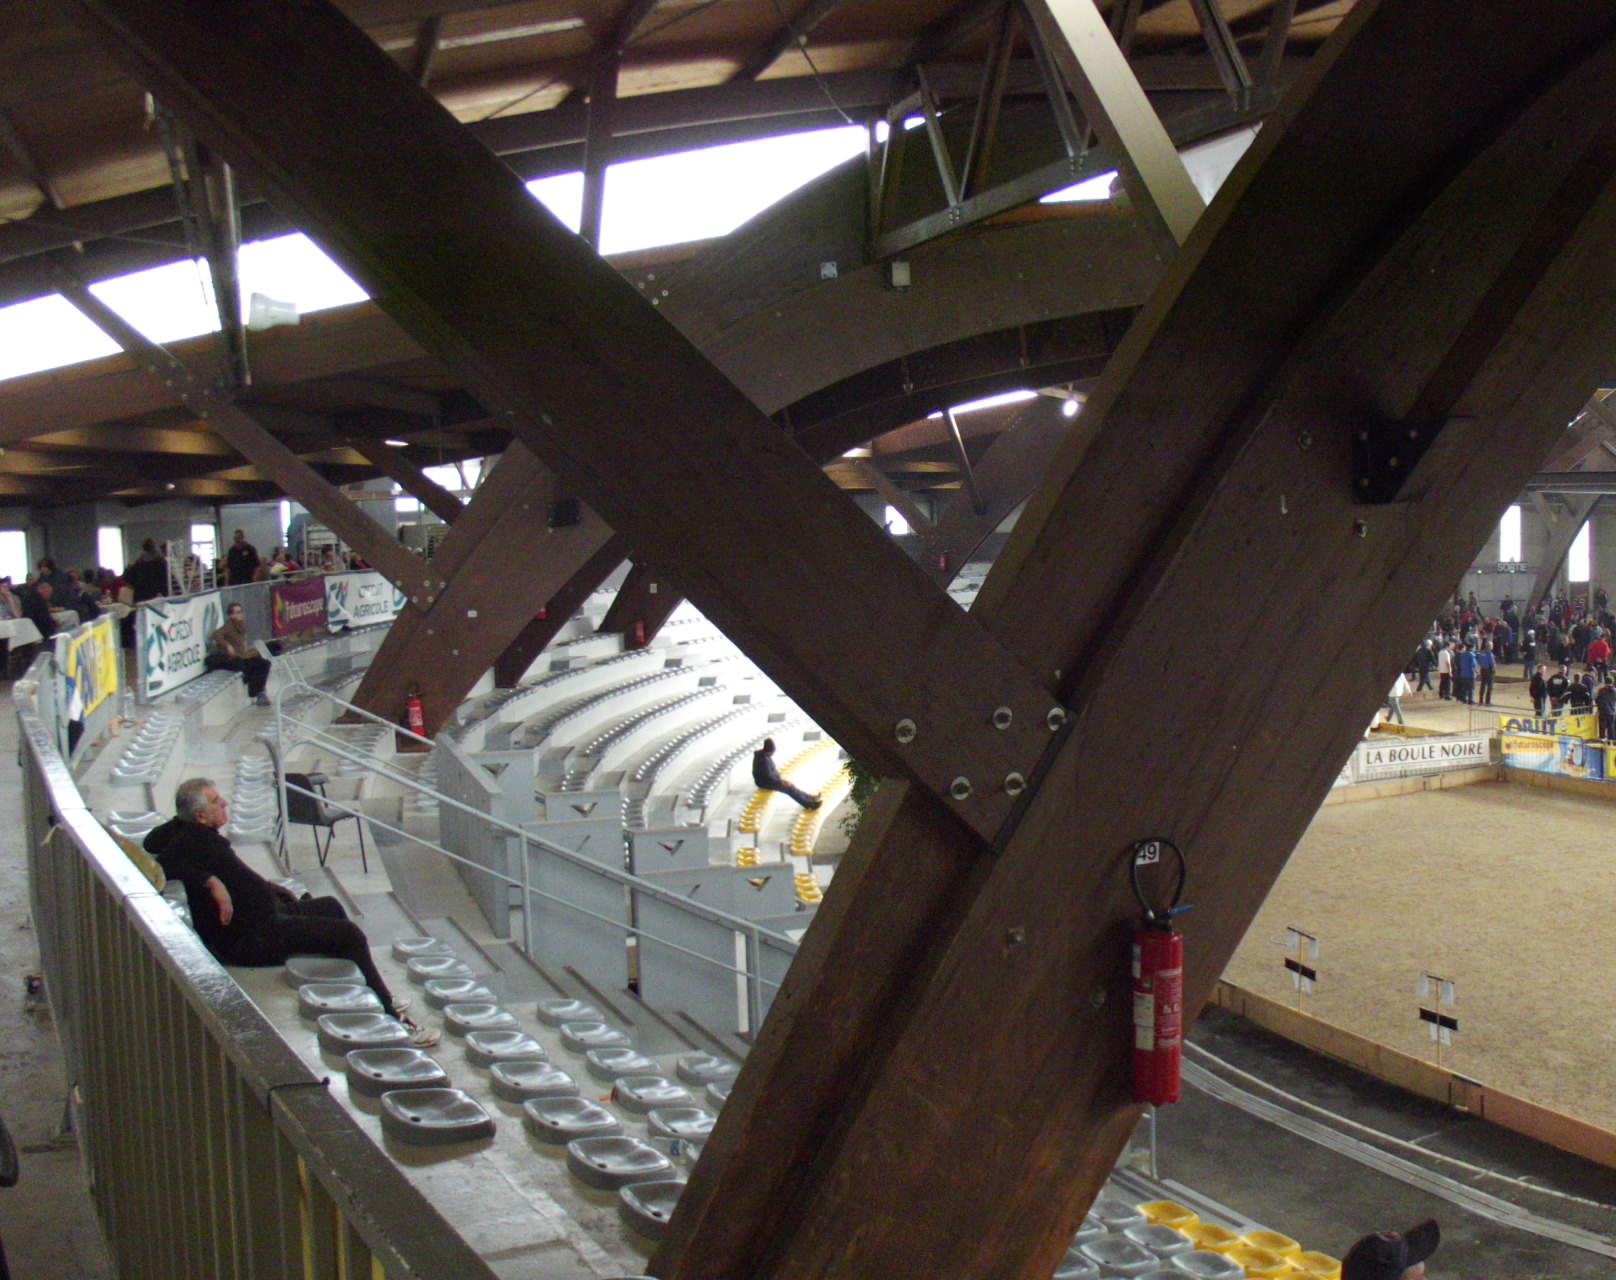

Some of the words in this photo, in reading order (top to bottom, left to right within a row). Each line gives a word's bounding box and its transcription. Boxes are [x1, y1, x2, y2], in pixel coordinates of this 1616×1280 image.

[1366, 750, 1383, 765] LA
[1388, 745, 1435, 763] BOULE
[1440, 742, 1483, 758] NOIRE
